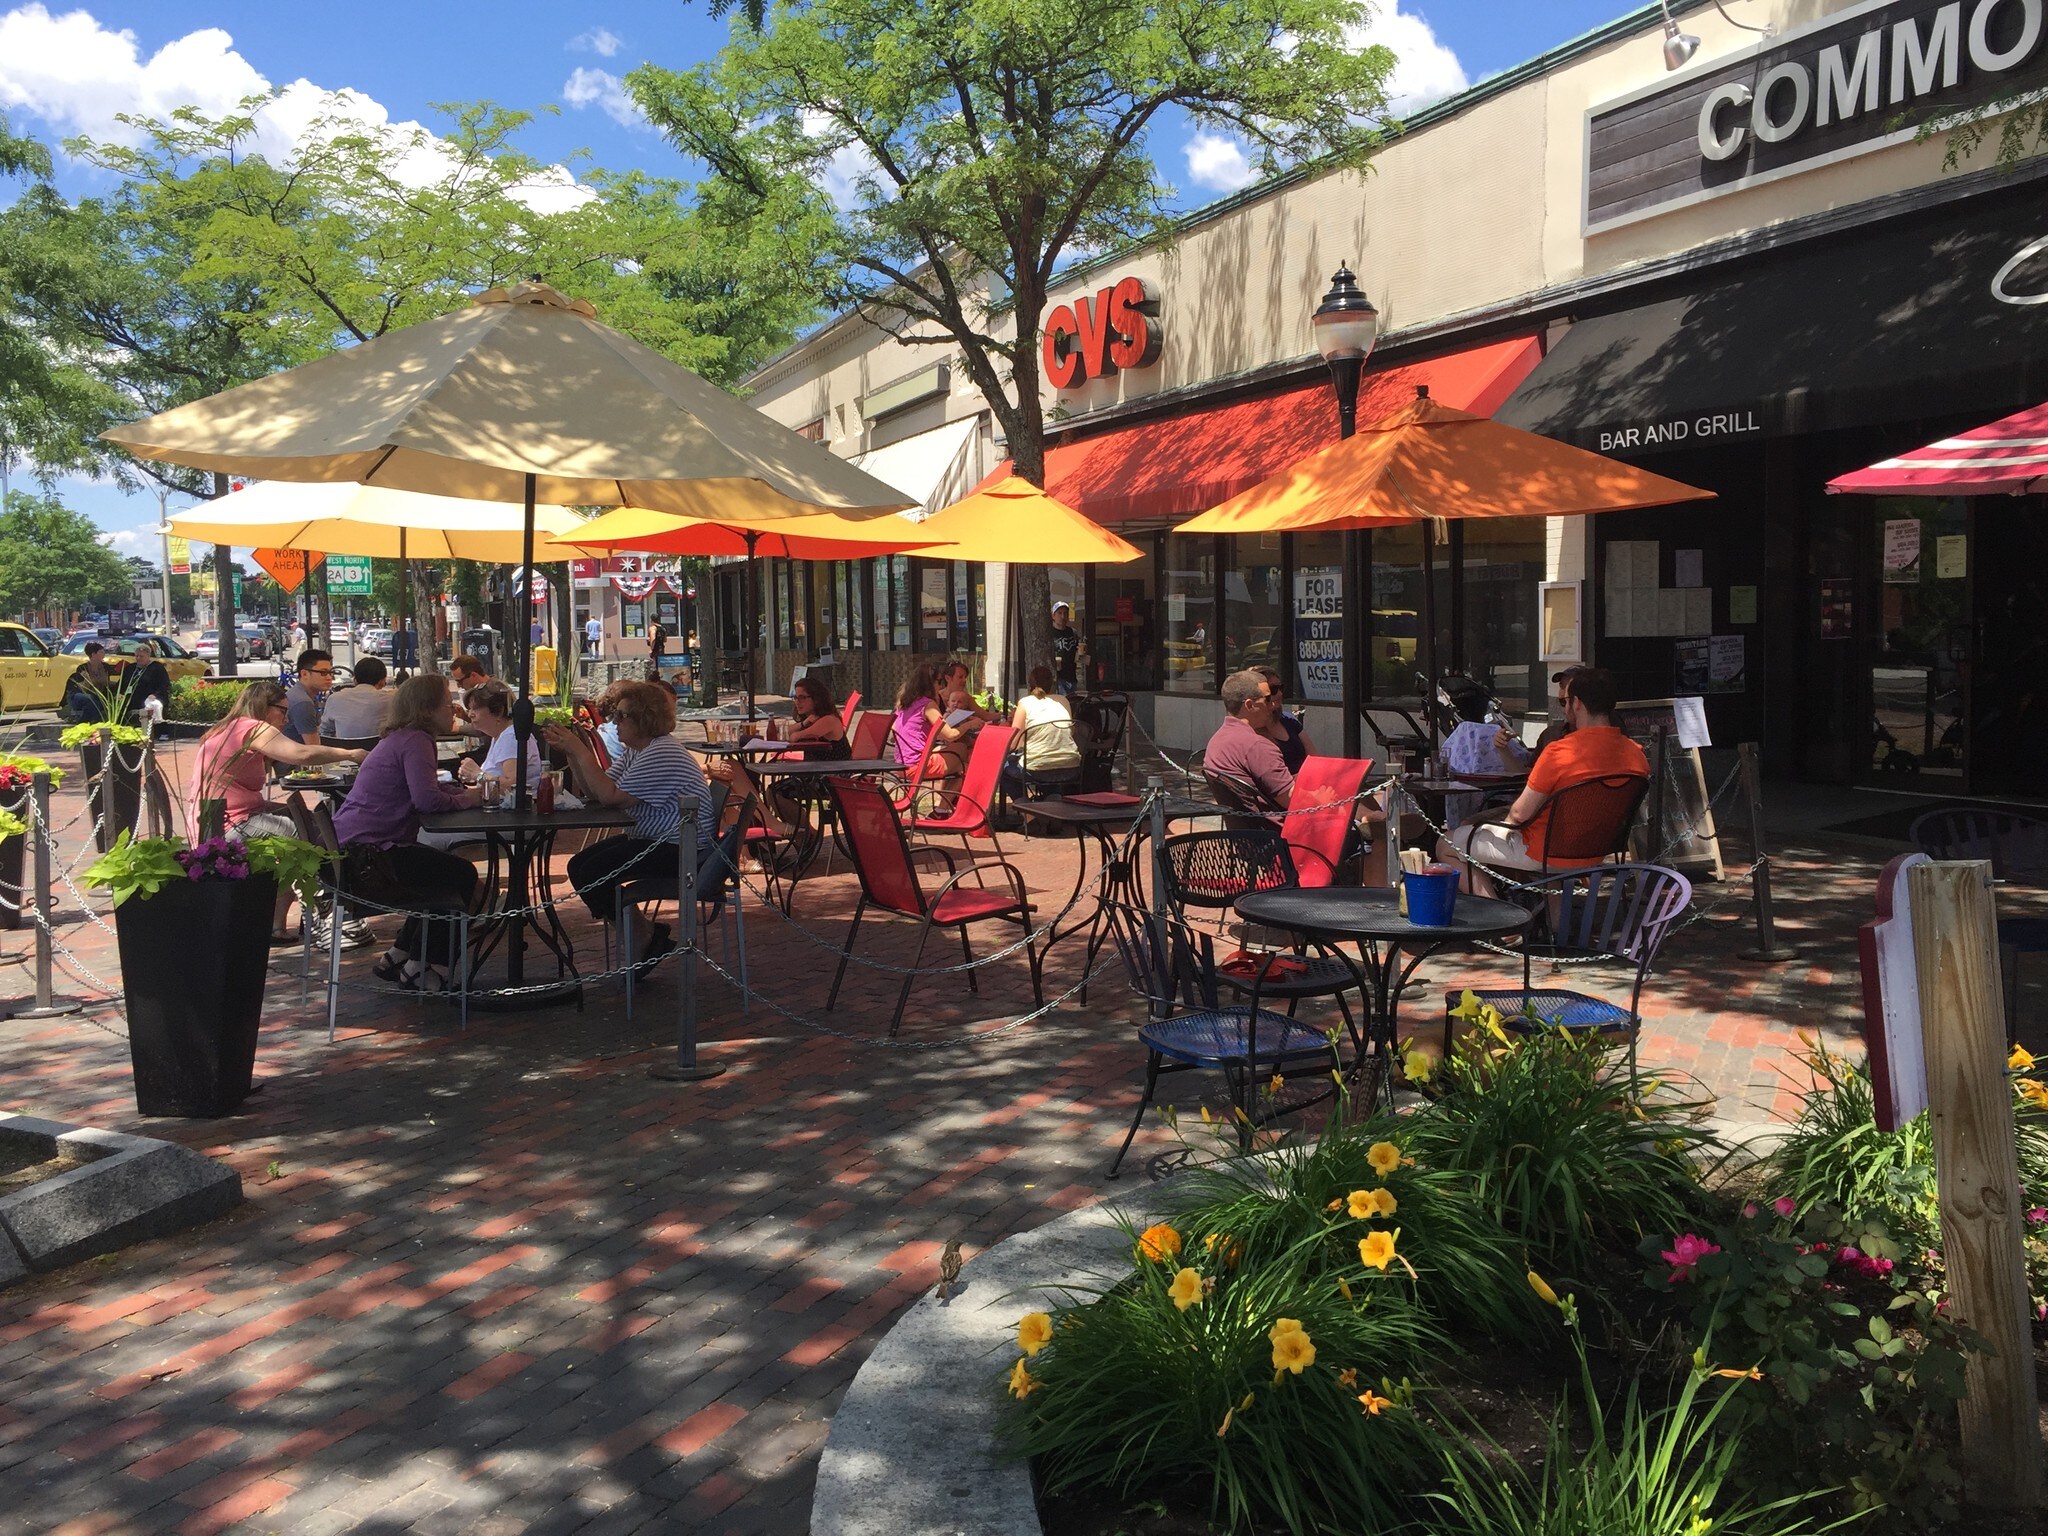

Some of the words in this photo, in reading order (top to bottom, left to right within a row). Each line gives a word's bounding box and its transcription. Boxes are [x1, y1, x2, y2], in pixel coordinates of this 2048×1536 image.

[1698, 0, 2043, 161] COMMO
[1043, 276, 1149, 389] CVS
[1600, 428, 1640, 451] BAR
[1644, 420, 1688, 445] AND
[1695, 411, 1760, 437] GRILL
[274, 549, 301, 558] WORK
[326, 556, 343, 565] WEST
[344, 556, 365, 565] NORTH
[272, 561, 305, 570] AHEAD
[328, 570, 342, 580] 2A
[350, 570, 357, 580] 3
[1305, 579, 1335, 596] FOR
[1298, 597, 1342, 615] LEASE
[1311, 621, 1330, 639] 617
[34, 669, 52, 679] TAXI
[1307, 665, 1328, 681] ACS
